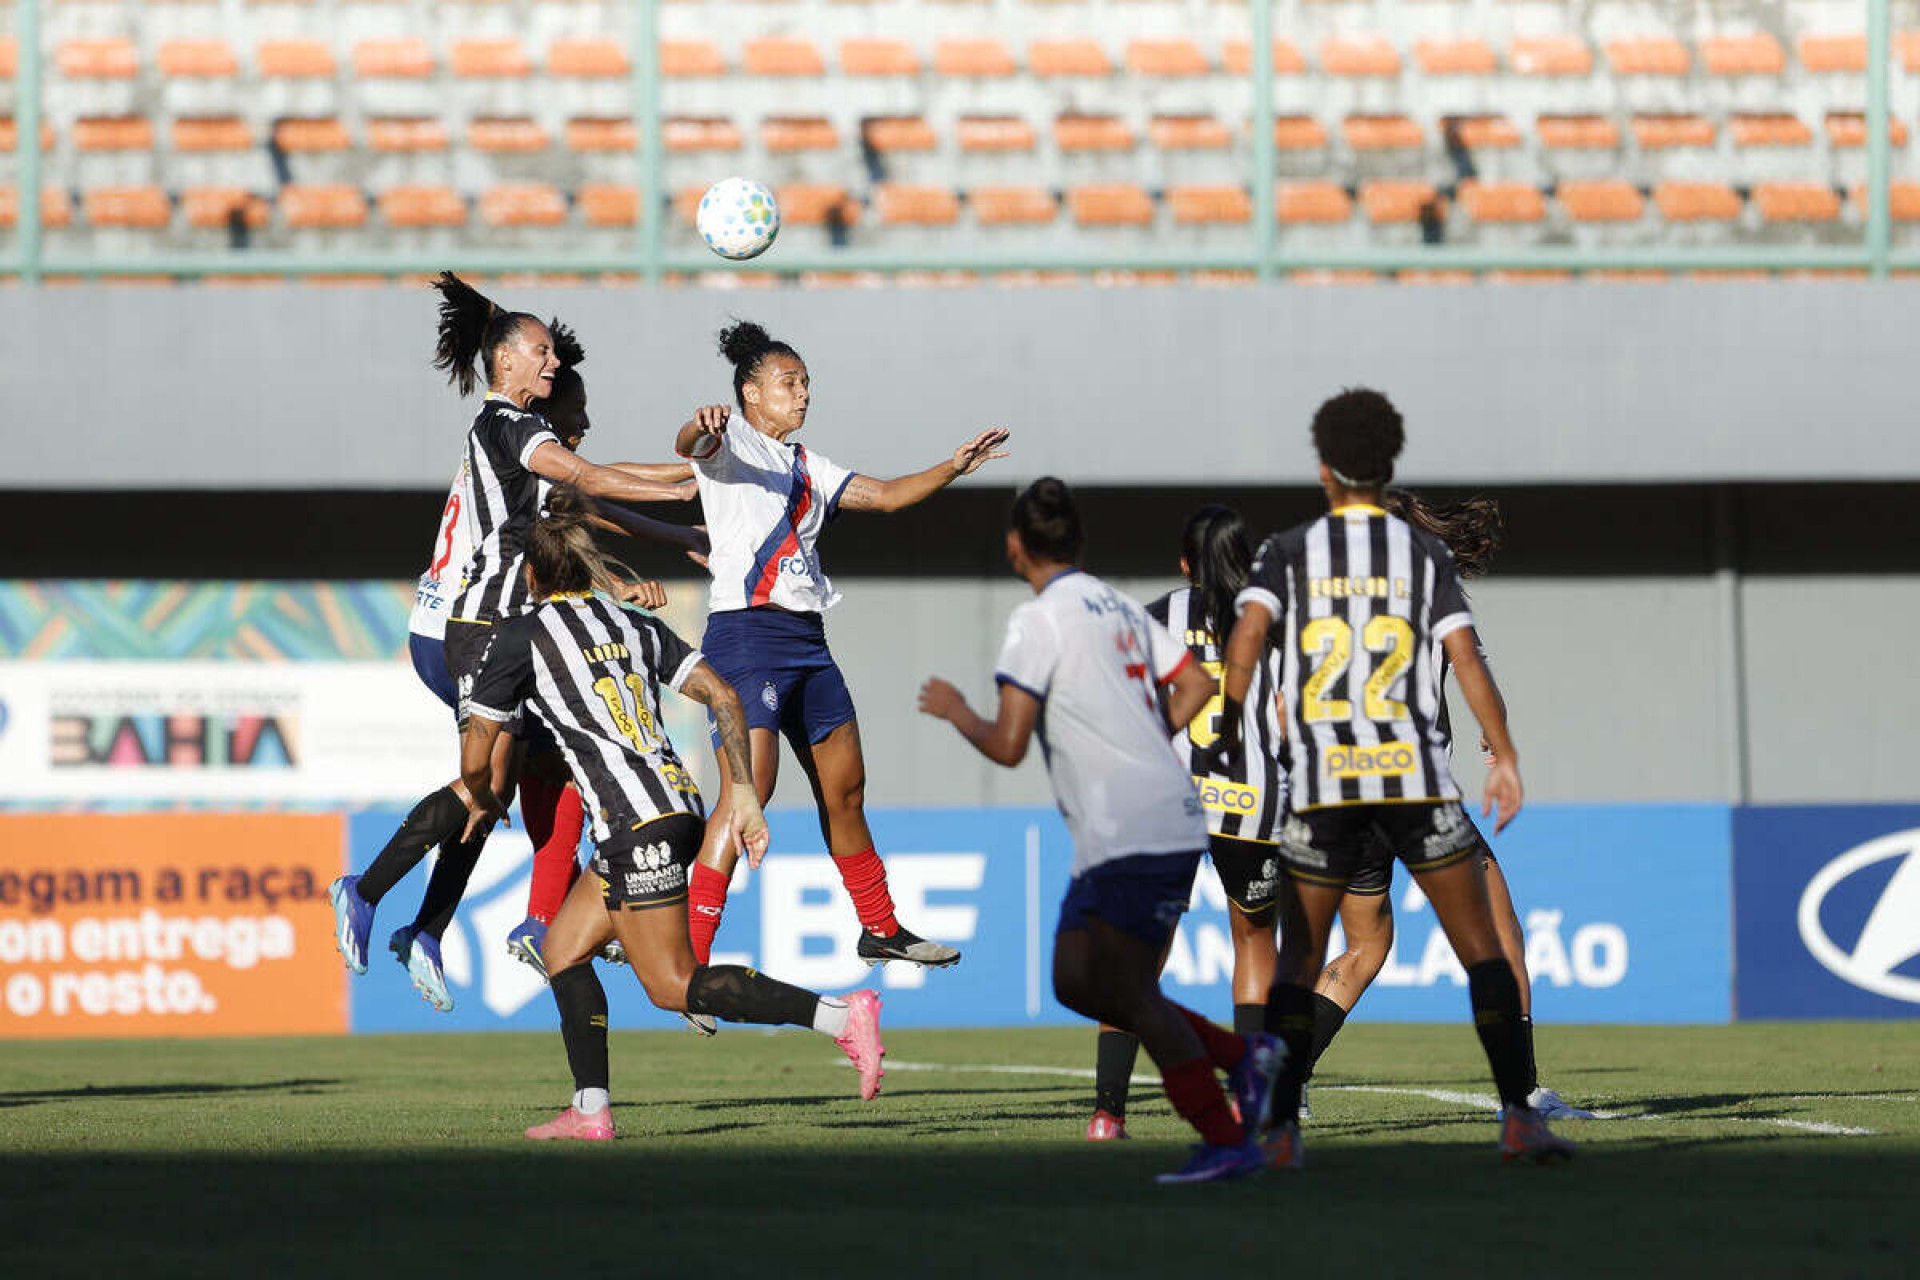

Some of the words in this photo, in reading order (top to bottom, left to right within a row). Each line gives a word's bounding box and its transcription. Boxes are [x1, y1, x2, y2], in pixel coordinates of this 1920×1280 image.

[1300, 614, 1416, 724] 22
[592, 673, 664, 753] 11
[50, 714, 298, 768] BAHIA
[1326, 748, 1415, 776] placo
[1197, 778, 1256, 810] laco
[156, 868, 184, 901] a
[70, 907, 296, 969] entrega
[5, 973, 45, 1016] o
[51, 962, 218, 1015] resto.
